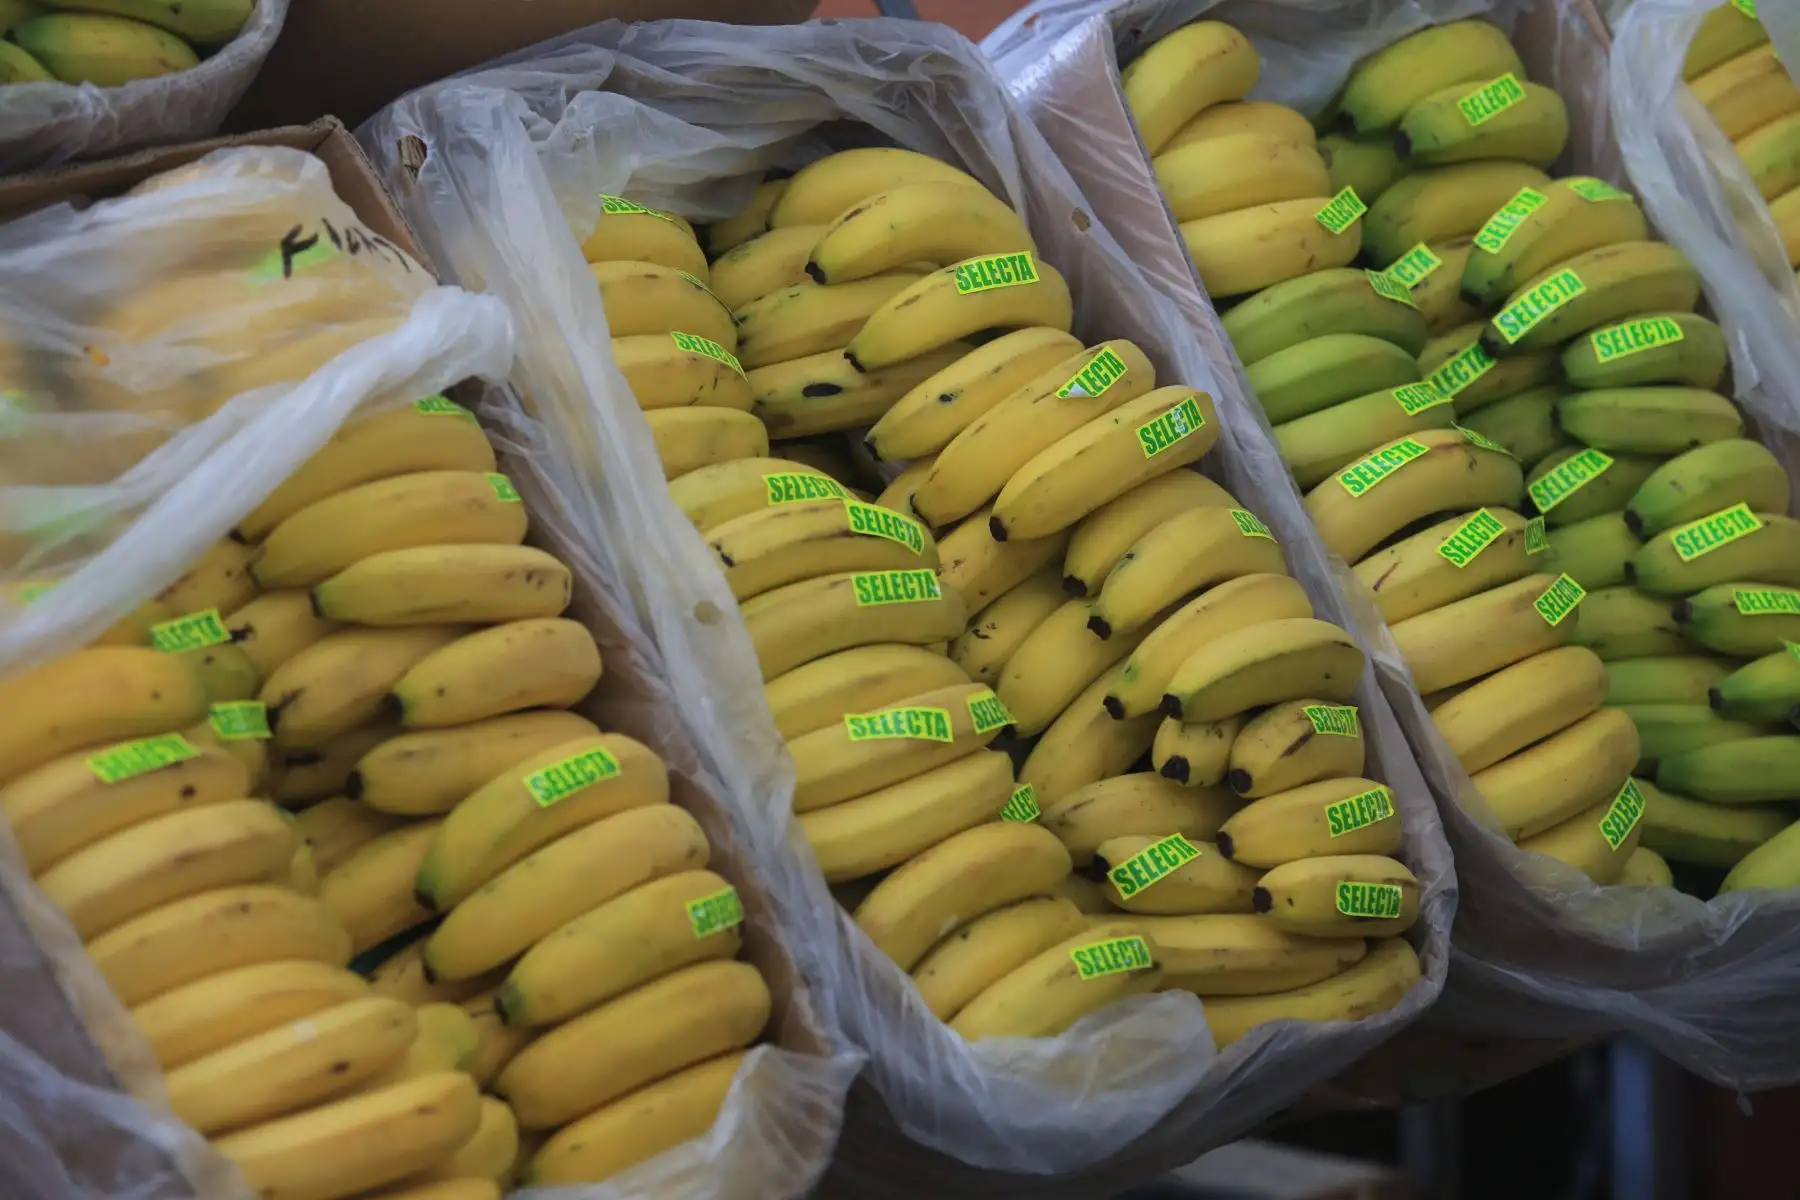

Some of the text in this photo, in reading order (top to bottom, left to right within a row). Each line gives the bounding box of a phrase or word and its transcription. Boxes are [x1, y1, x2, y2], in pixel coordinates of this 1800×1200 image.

[955, 254, 1034, 292] SELECTA
[1498, 271, 1584, 336] SELECTA
[1596, 318, 1679, 357] SELECTA
[1058, 351, 1126, 397] LECTA
[1139, 398, 1204, 456] SELECTA
[1341, 439, 1428, 494] SELECTA
[1532, 459, 1606, 508] SELECTA
[850, 505, 922, 552] SELECTA
[1440, 511, 1502, 565] SELECTA
[1675, 508, 1758, 556] SELECTA
[855, 570, 939, 604] SELECTA
[849, 709, 949, 740] SELECTA
[532, 751, 617, 801] SELECTA
[1113, 836, 1199, 896] SELECTA
[1339, 882, 1400, 916] SELECTA
[1074, 938, 1150, 977] SELECTA
